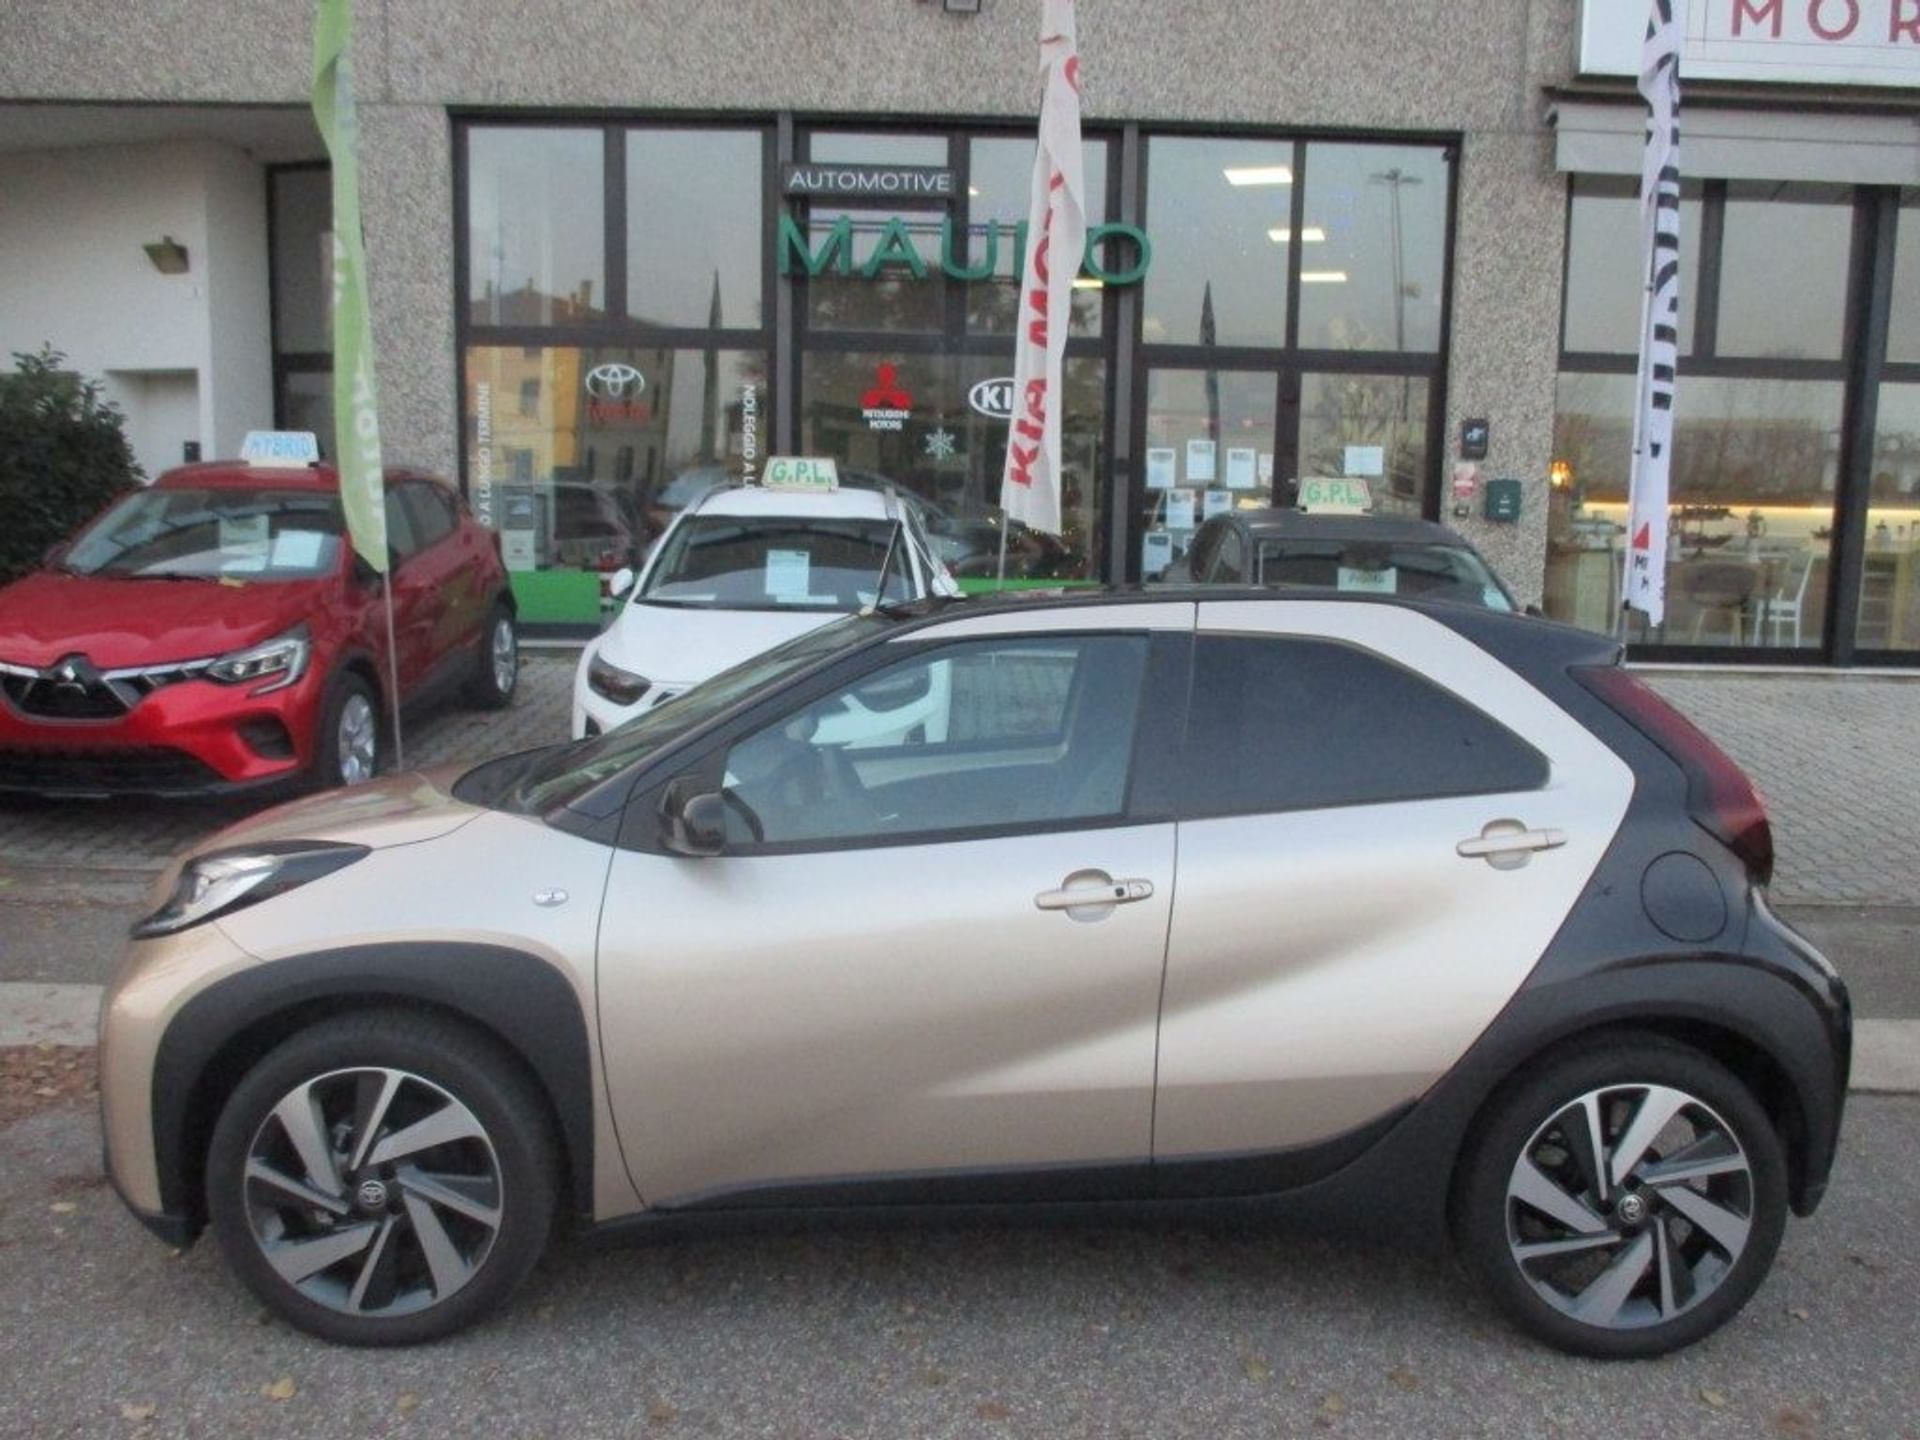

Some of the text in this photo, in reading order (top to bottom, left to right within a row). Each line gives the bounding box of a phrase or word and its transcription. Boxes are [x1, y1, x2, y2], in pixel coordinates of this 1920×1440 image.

[788, 170, 951, 193] AUTOMOTIVE
[478, 382, 491, 443] TERMINE
[743, 384, 756, 460] NOLEGGIO
[982, 386, 1014, 411] KI
[478, 448, 492, 498] LUNGO
